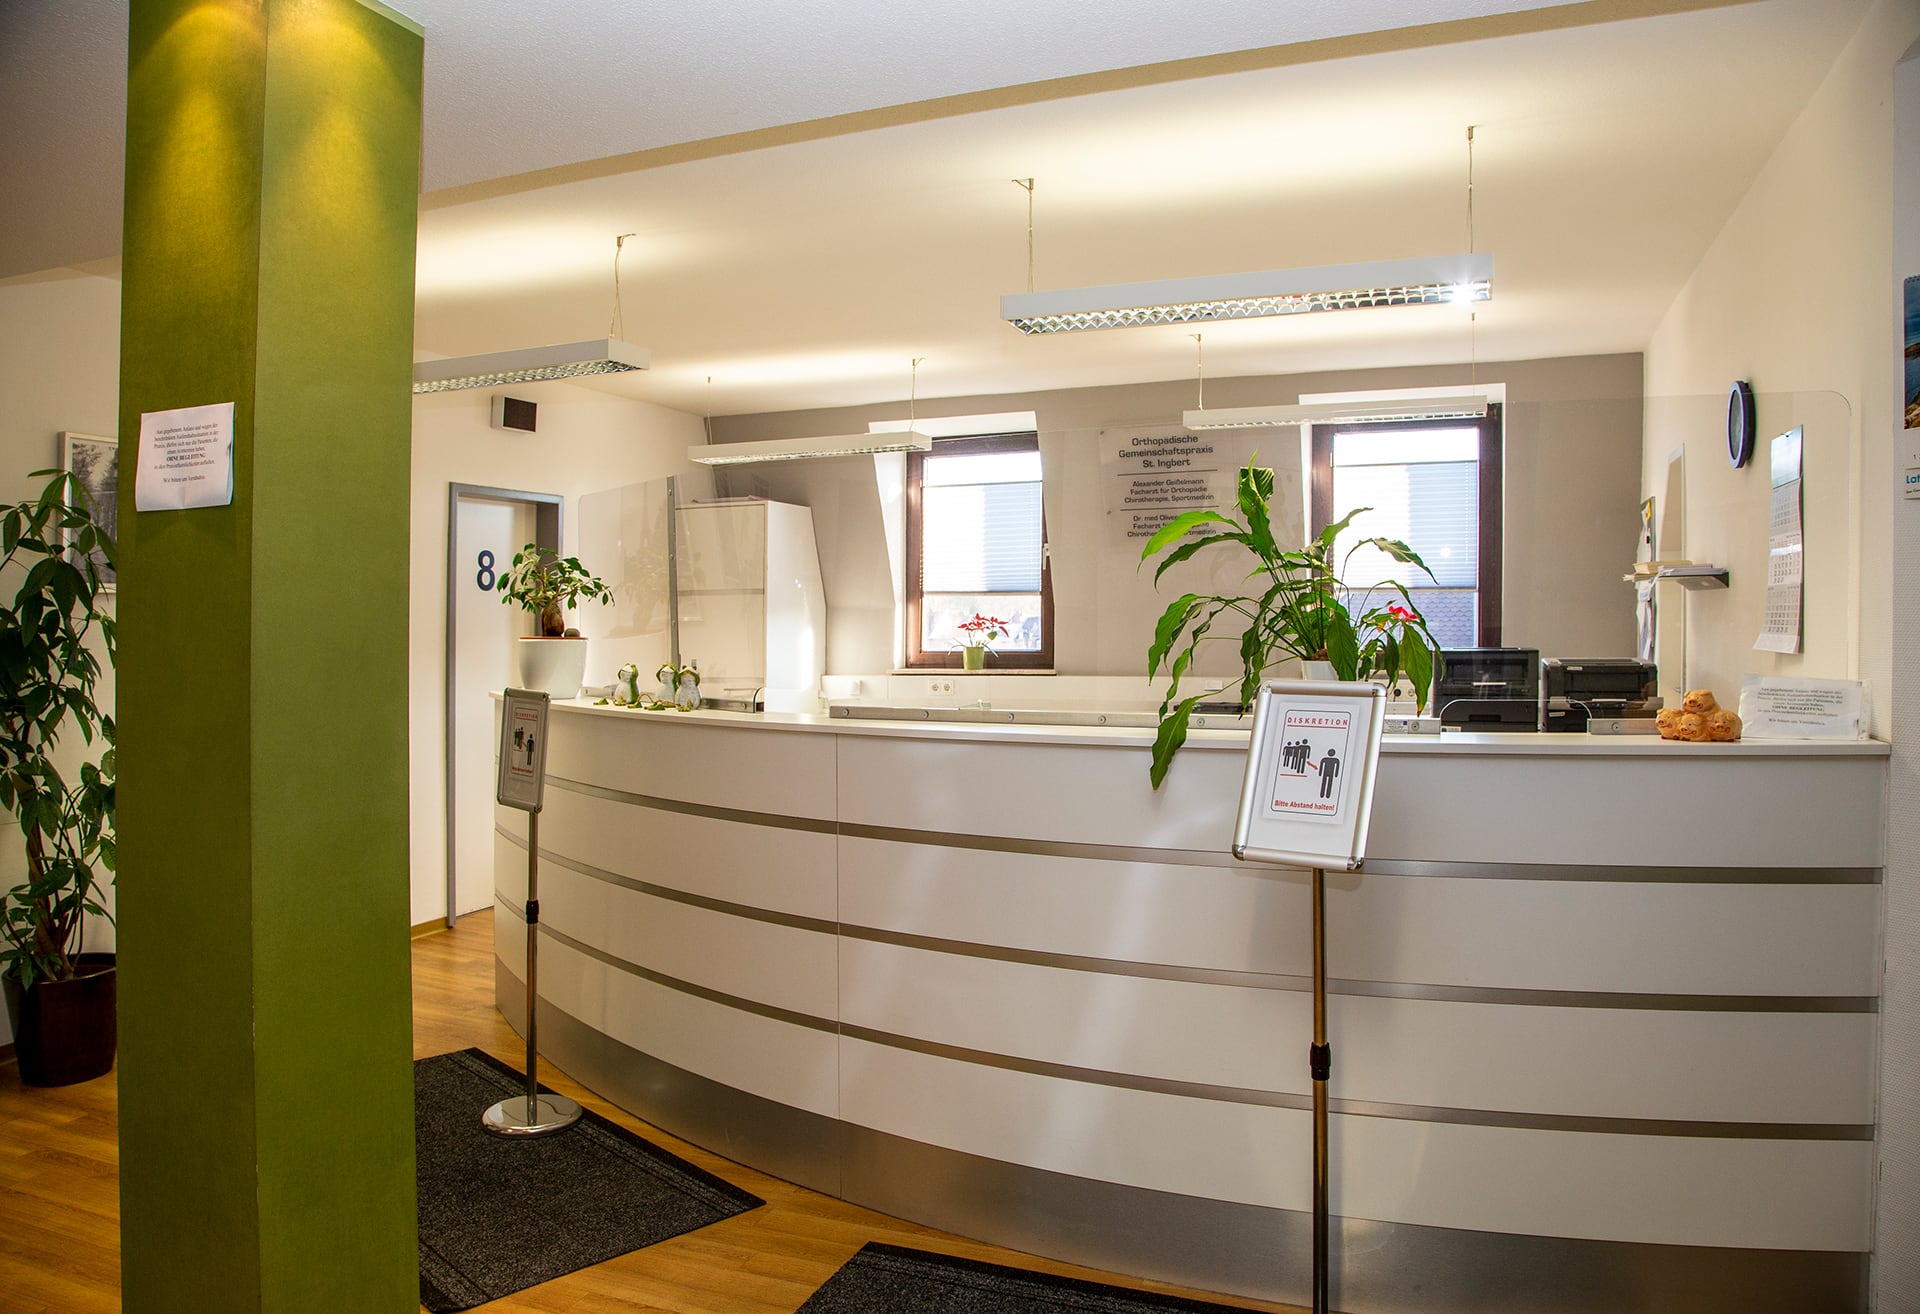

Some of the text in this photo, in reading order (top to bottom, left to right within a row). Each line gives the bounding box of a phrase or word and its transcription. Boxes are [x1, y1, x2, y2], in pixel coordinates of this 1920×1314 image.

[1132, 434, 1198, 447] Orthopädische
[1118, 444, 1214, 458] Gemeinschaftspraxis
[1142, 458, 1191, 469] St. Ingbert
[1132, 480, 1164, 488] Alexander
[1171, 486, 1207, 494] Orthopädie
[1171, 494, 1214, 502] Sportmedizin
[477, 550, 495, 591] 8
[1287, 717, 1348, 726] DISKRETION
[1289, 801, 1314, 810] Abstand
[1314, 802, 1335, 811] halten!
